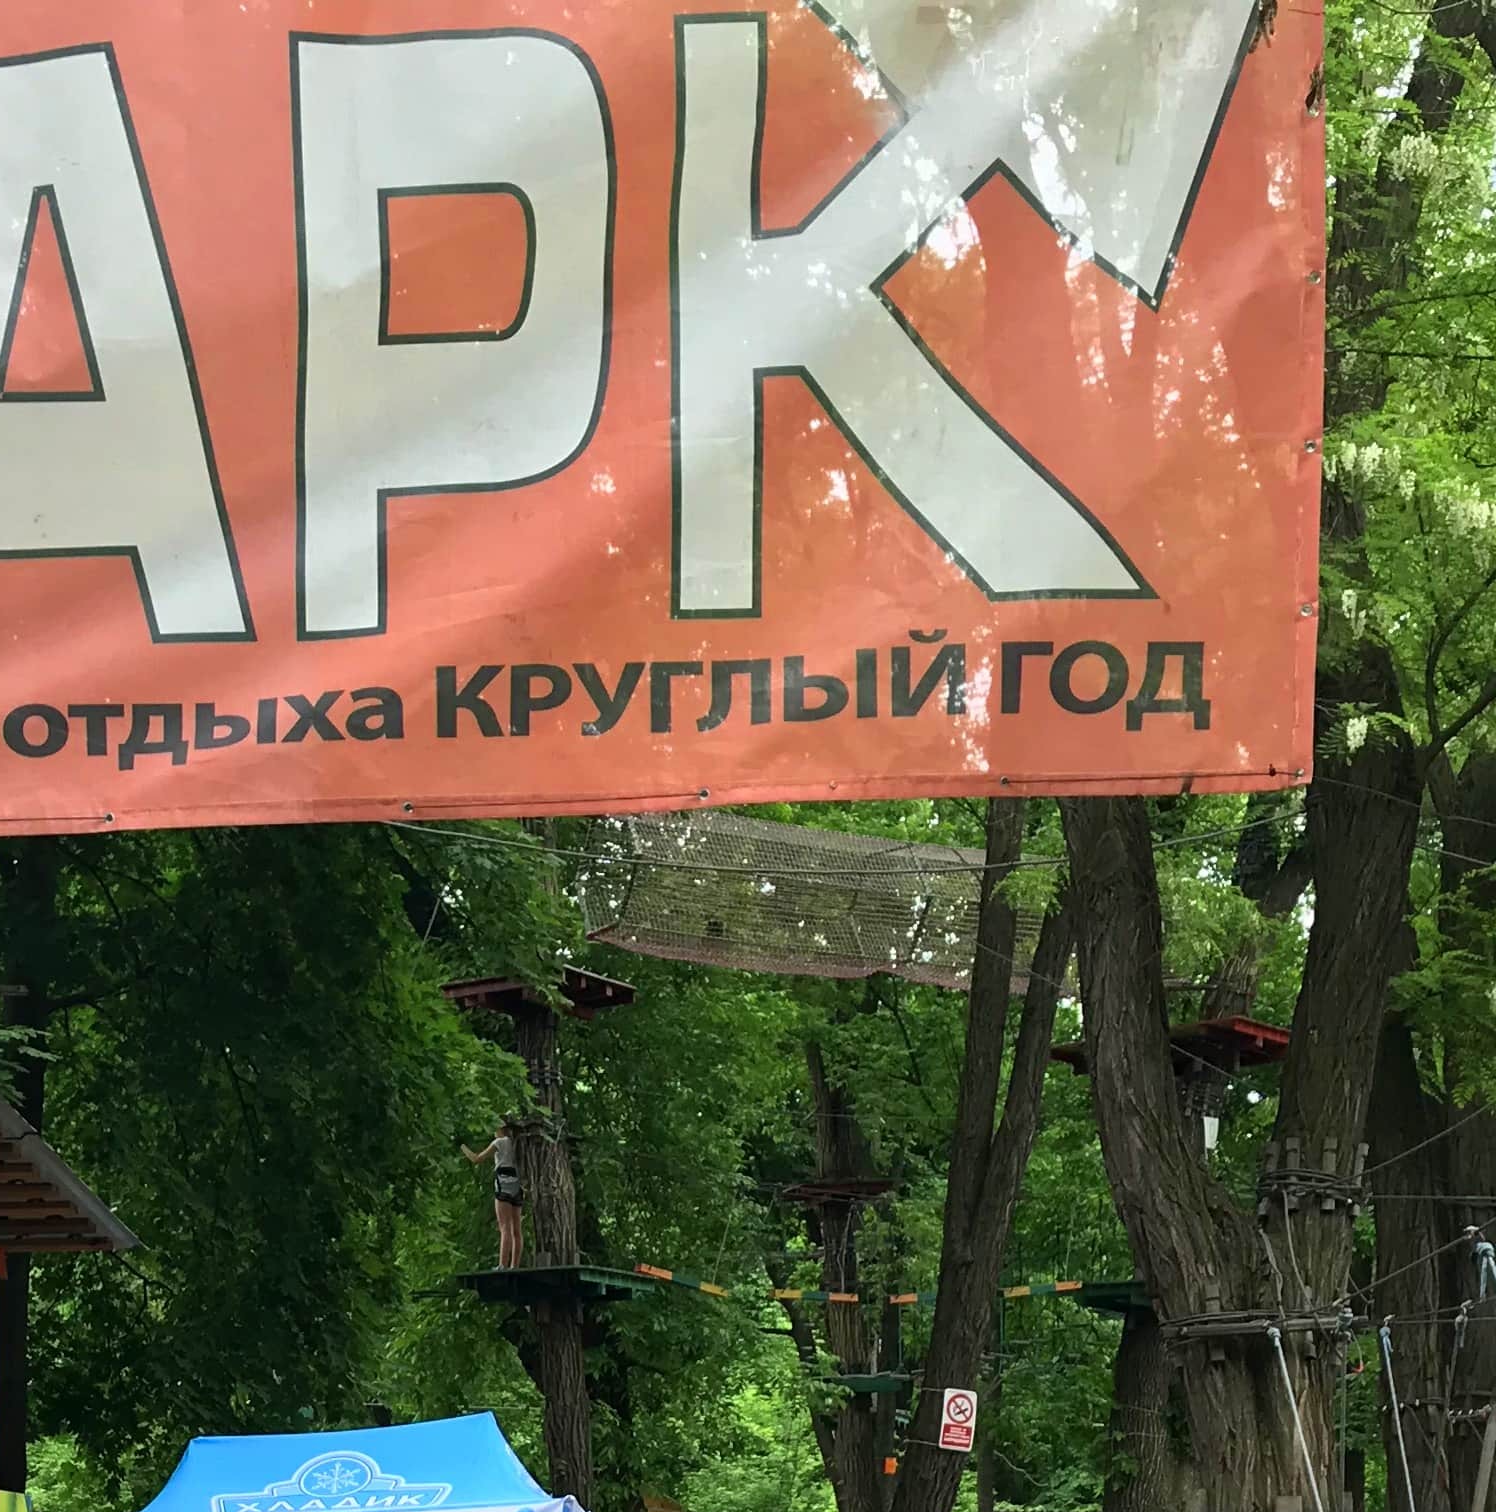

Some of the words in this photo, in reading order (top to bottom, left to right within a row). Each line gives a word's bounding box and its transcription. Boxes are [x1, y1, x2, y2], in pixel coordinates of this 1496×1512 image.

[1, 688, 402, 771] отдыха
[435, 629, 967, 741] КРУГЛЫЙ
[997, 638, 1213, 734] ГОД
